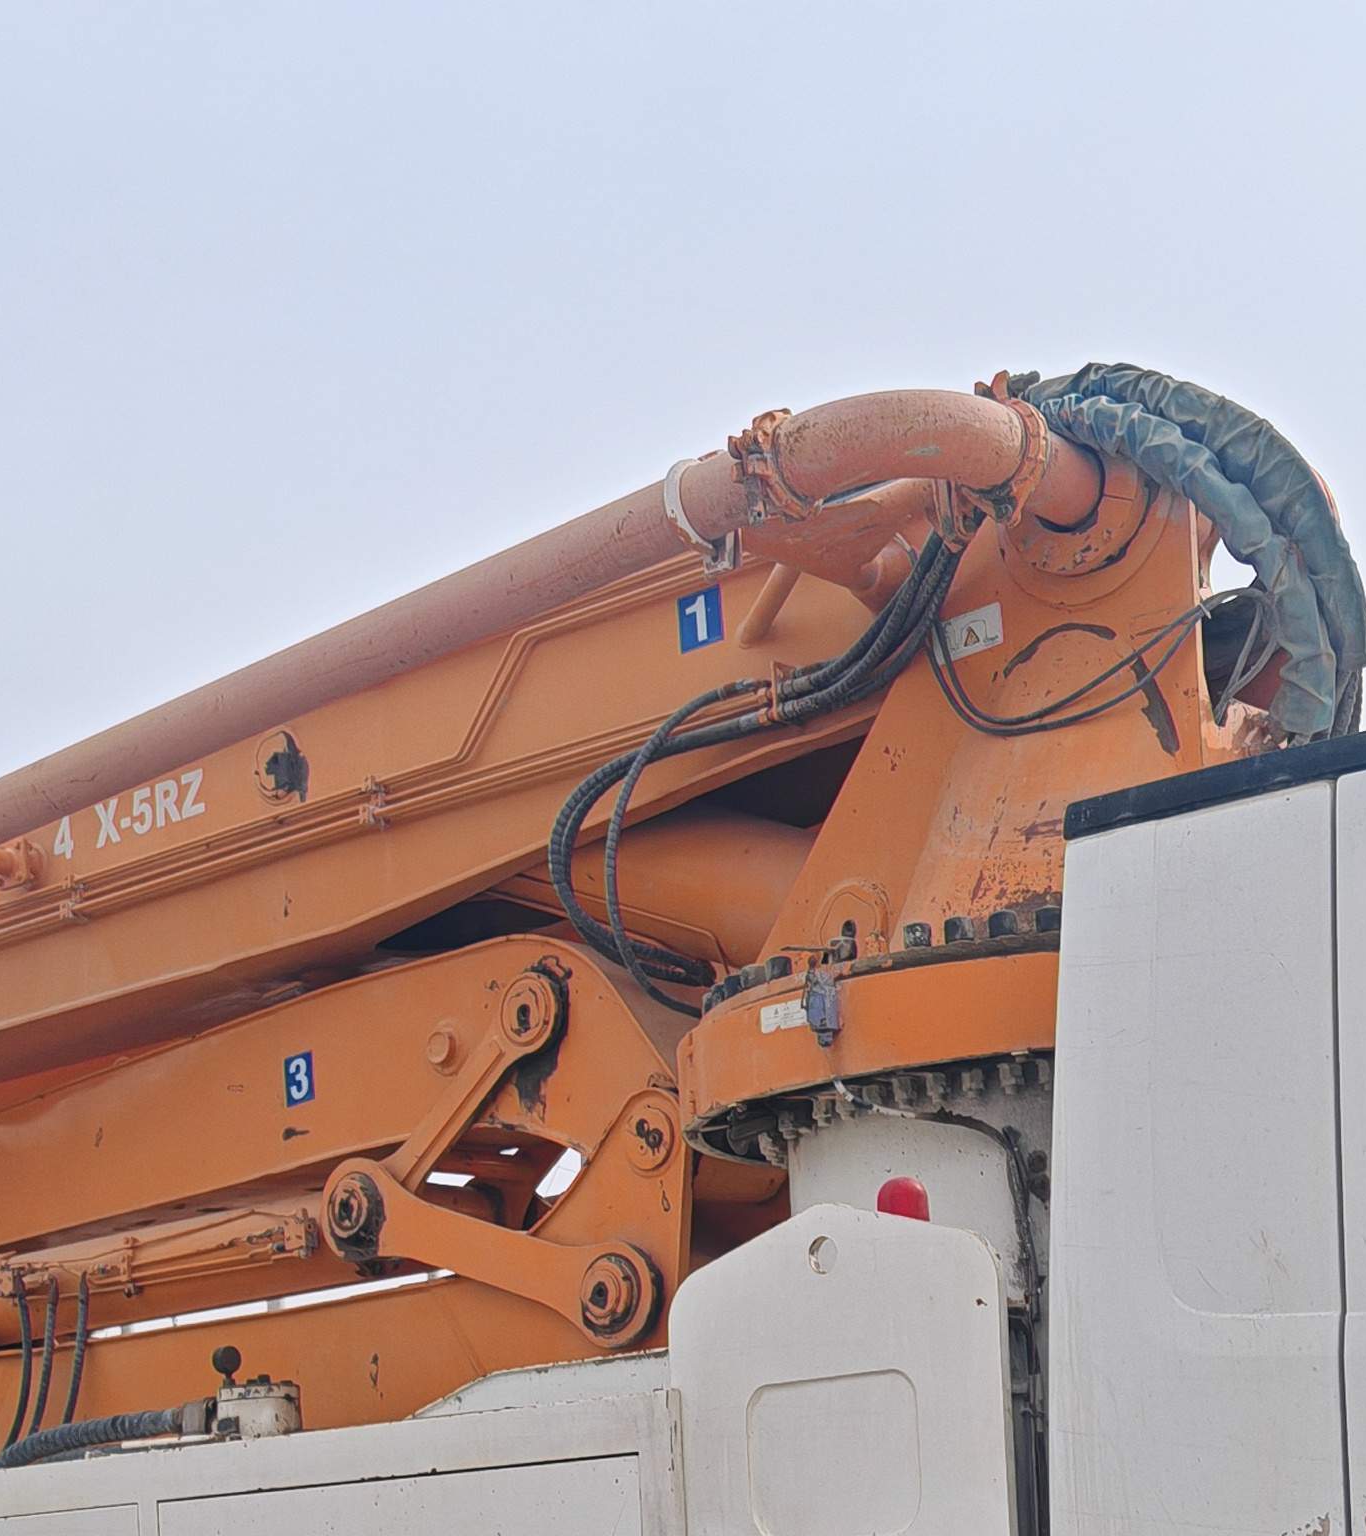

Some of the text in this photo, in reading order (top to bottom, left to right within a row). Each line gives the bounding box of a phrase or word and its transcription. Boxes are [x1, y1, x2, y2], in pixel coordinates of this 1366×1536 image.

[685, 594, 709, 642] 1
[53, 768, 206, 860] 4 X-5RZ
[288, 1057, 309, 1100] 3
